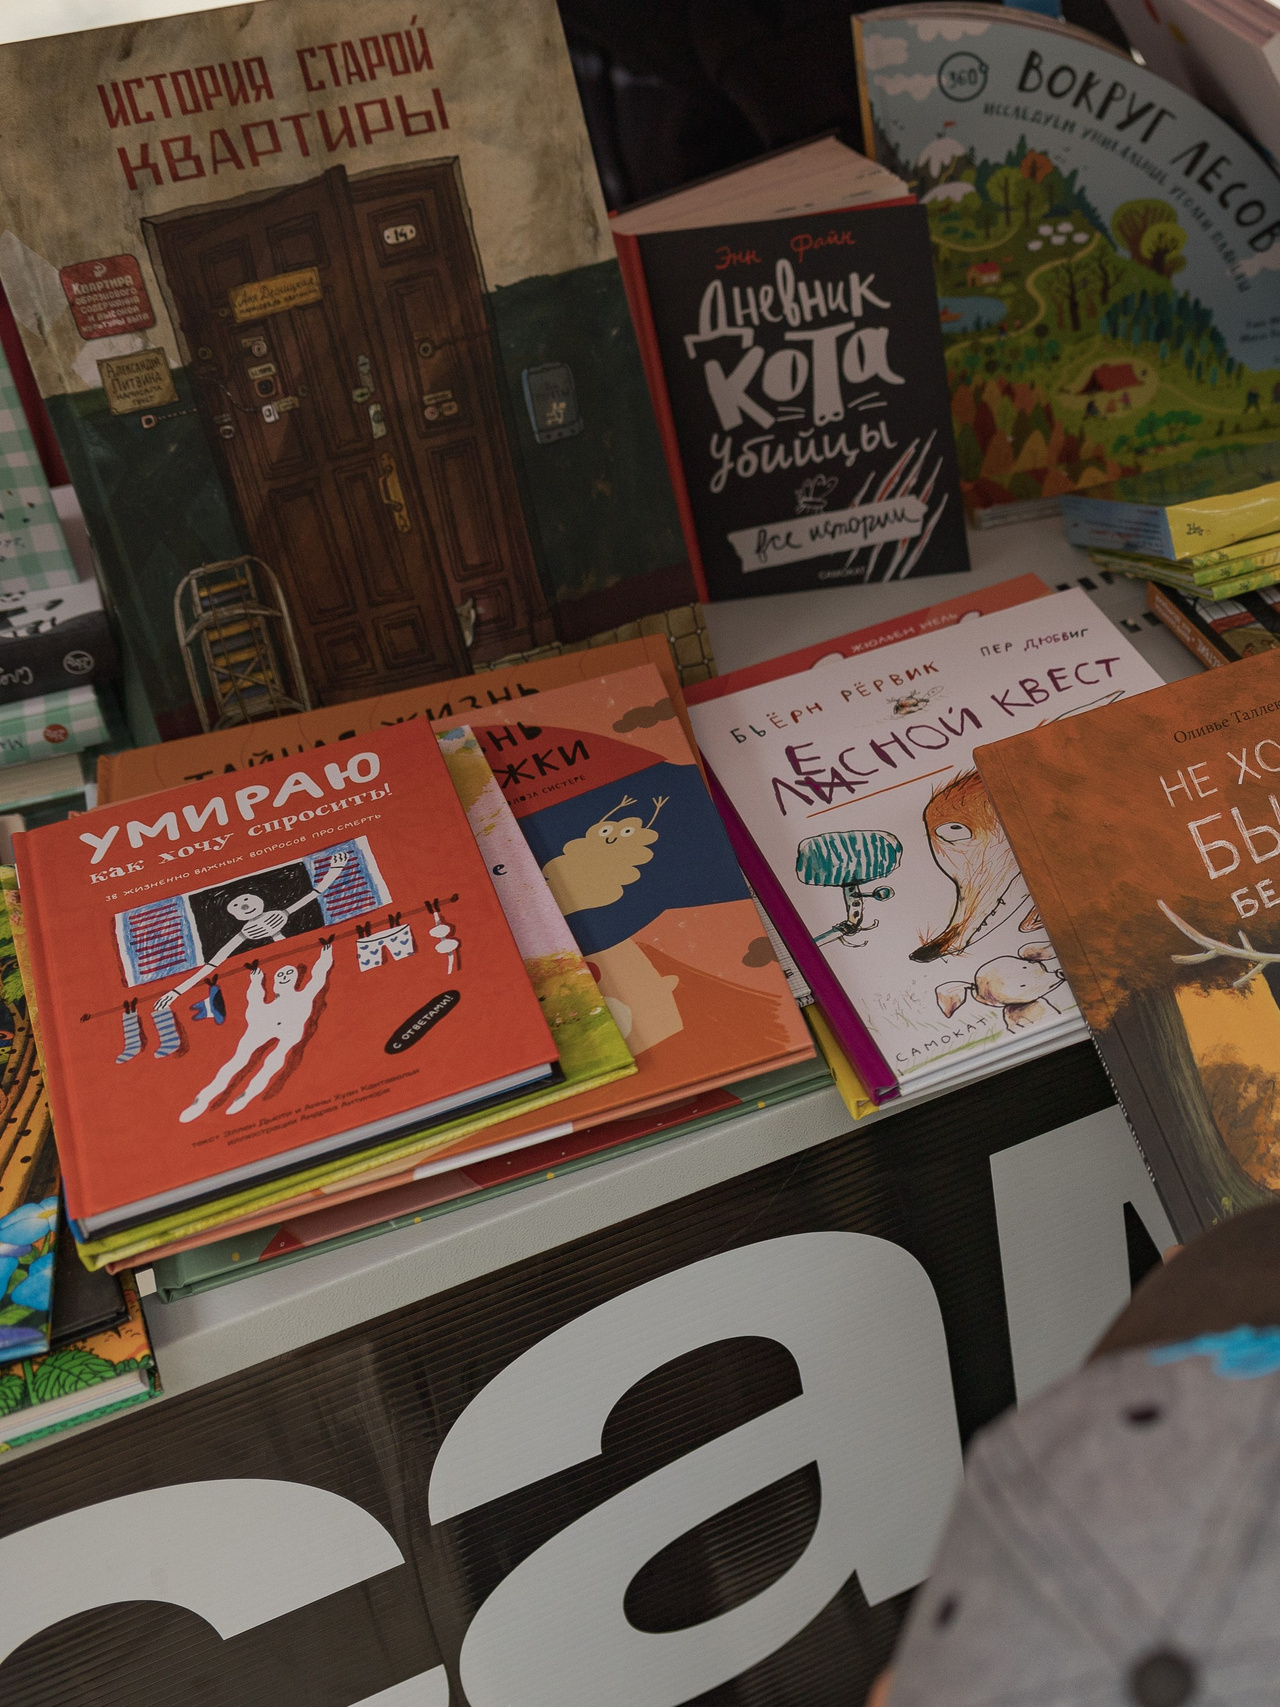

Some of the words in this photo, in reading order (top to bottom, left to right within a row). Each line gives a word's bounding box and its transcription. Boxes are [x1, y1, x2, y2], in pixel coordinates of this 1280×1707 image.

[97, 56, 274, 129] ИСТОРИЯ
[295, 15, 435, 92] СТАРОЙ
[1018, 50, 1178, 143] ВОКРУГ
[116, 88, 450, 190] КВАРТИРЫ
[394, 227, 409, 242] 14
[714, 246, 761, 271] Энн
[790, 229, 856, 263] Файн
[71, 274, 134, 295] КВАРТИРА
[684, 260, 891, 358] Дневник
[755, 527, 801, 563] все
[809, 505, 921, 544] истории
[980, 643, 1013, 656] ПЕР
[1023, 628, 1088, 652] ДЮБВИГ
[730, 700, 824, 745] БЬЁРН
[840, 661, 940, 704] РЁРВИК
[991, 655, 1122, 718] КВЕСТ
[1173, 717, 1230, 745] Оливье
[79, 751, 382, 864] УМИРАЮ
[542, 774, 586, 795] СИСТЕРЕ
[1159, 761, 1219, 808] НЕ
[88, 859, 145, 885] как
[157, 830, 235, 867] хочу
[247, 782, 393, 842] спросить!
[123, 870, 191, 901] ЖИЗНЕННО
[194, 854, 244, 877] ВАЖНЫХ
[249, 835, 307, 861] ВОПРОСОВ
[311, 828, 335, 841] ПРО
[337, 814, 382, 834] СМЕРТЬ
[404, 992, 455, 1042] ОТВЕТАМИ!
[895, 1016, 988, 1064] САМОКАТ
